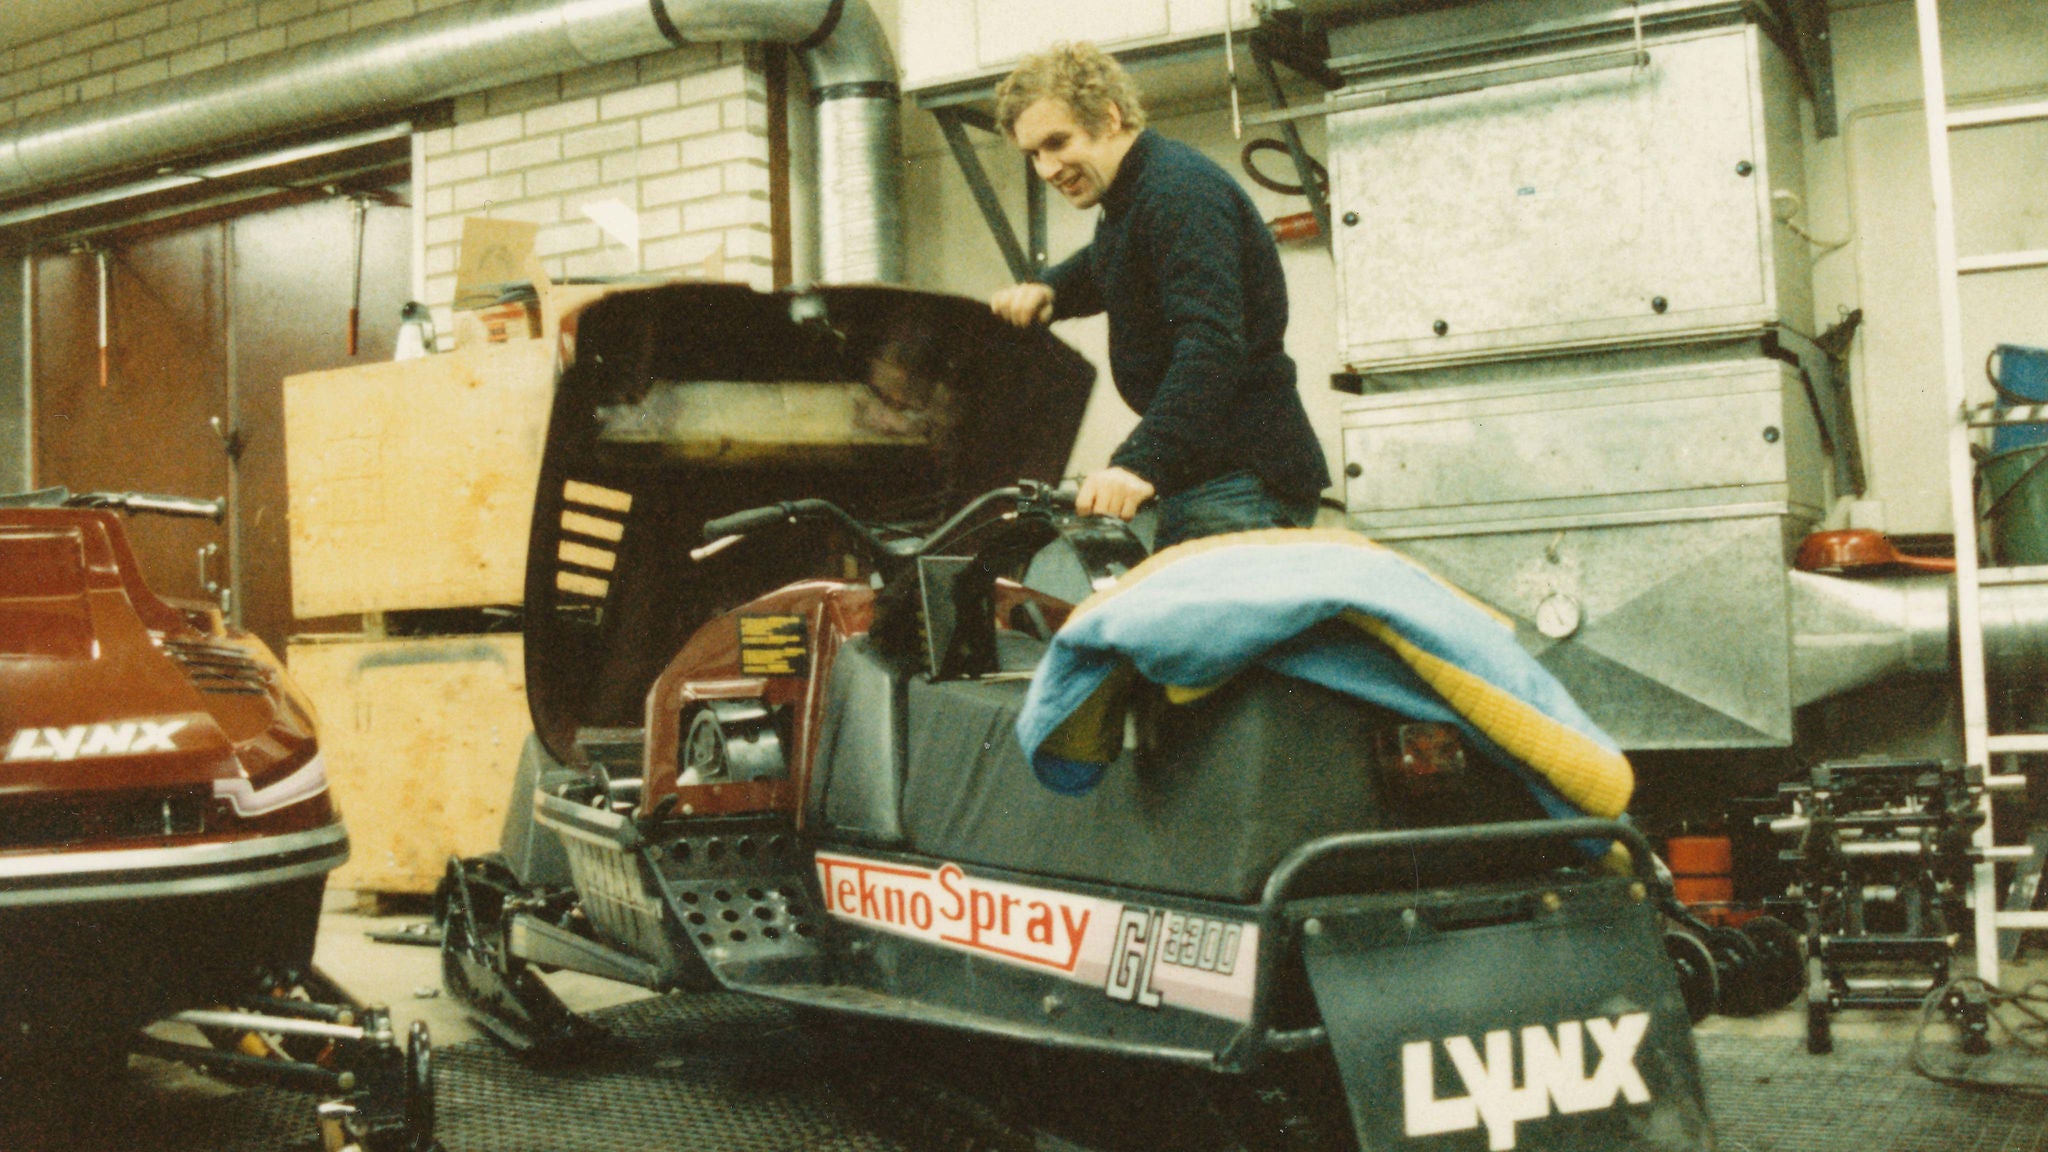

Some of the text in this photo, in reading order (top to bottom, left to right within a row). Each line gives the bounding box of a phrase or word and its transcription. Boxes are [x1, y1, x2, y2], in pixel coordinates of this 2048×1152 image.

[6, 719, 188, 761] LYNX
[1105, 904, 1164, 1010] GL
[1402, 1012, 1650, 1151] LYNX
